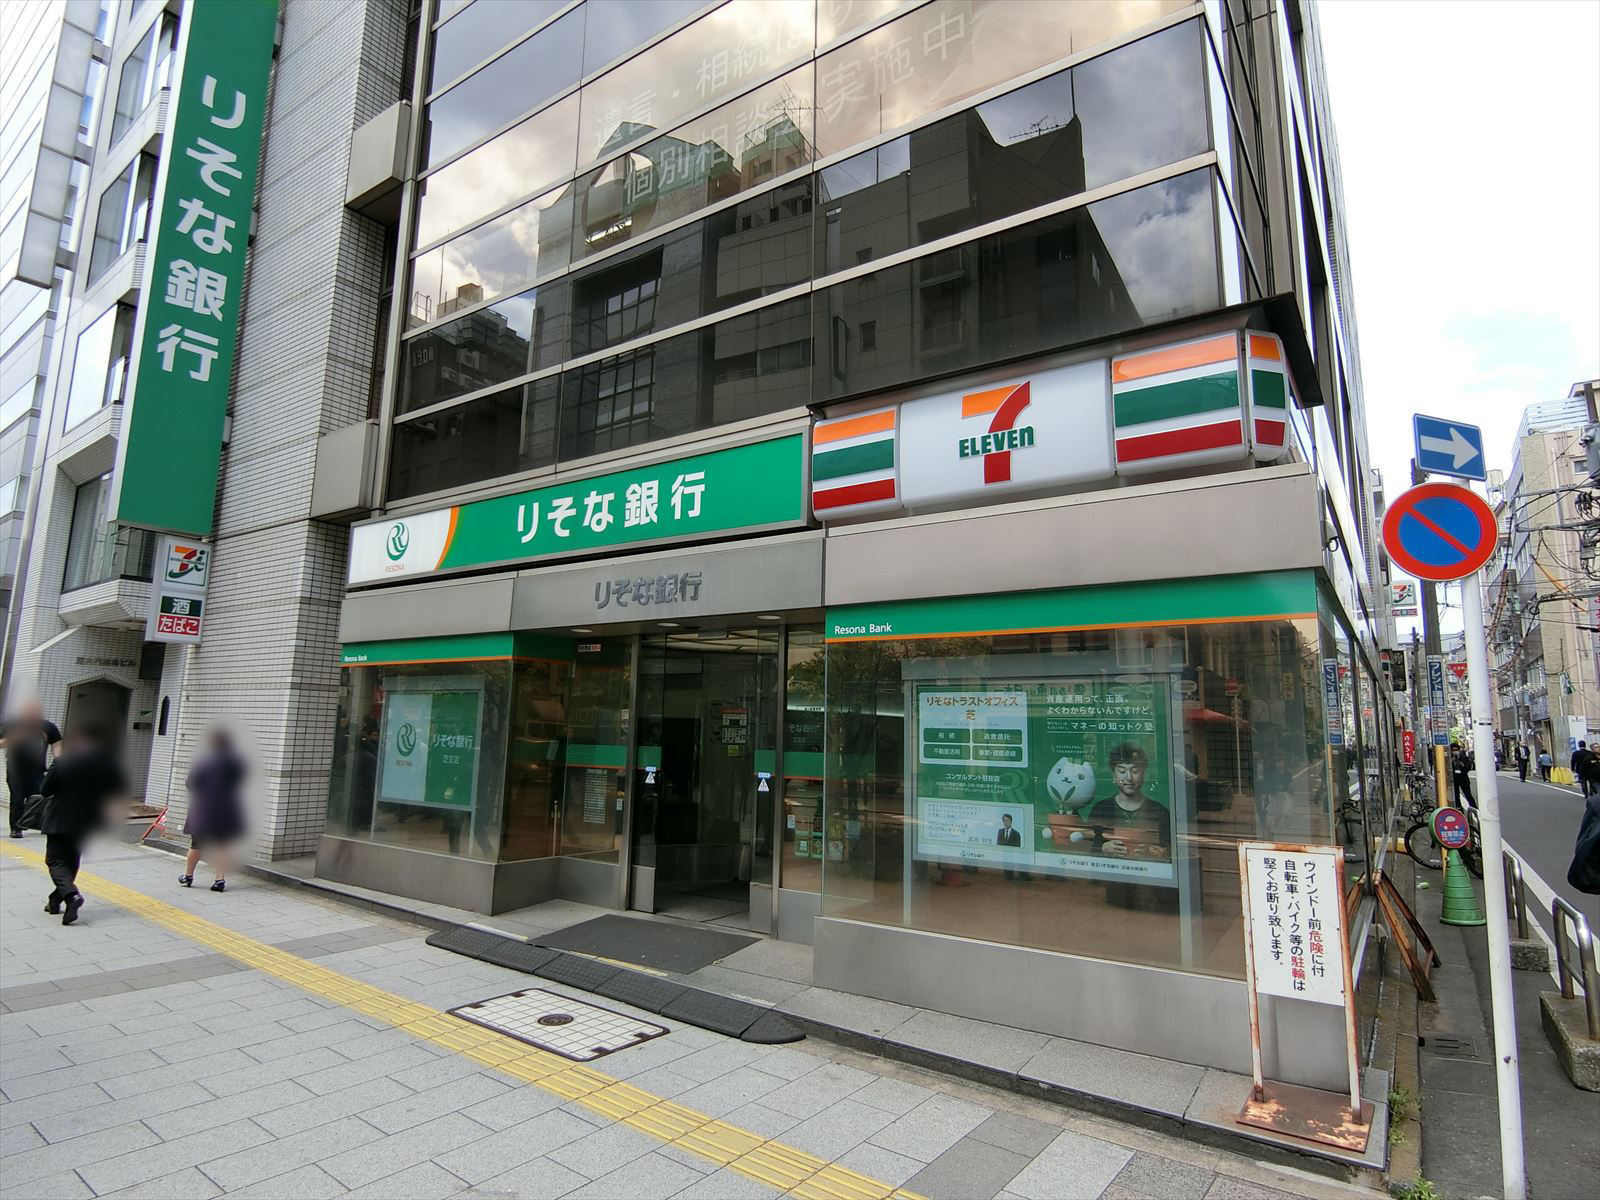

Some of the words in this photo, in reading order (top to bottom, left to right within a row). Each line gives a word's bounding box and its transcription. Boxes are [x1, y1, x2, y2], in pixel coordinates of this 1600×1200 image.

[156, 75, 246, 382] りそな銀行
[517, 470, 706, 544] りそな銀行
[385, 564, 405, 574] RESONA
[594, 571, 702, 609] りそな銀行
[172, 598, 191, 614] 酒
[159, 616, 198, 634] たばこ
[834, 624, 866, 635] Resona
[869, 622, 892, 633] Bank
[344, 654, 358, 662] Resona
[926, 696, 1018, 707] りそなトラストオフィス
[1046, 694, 1128, 704] 資産運用って、正直、
[965, 709, 976, 721] 芝
[1070, 721, 1154, 732] マネーの知っトク塾
[432, 734, 473, 749] りそな銀行
[443, 755, 460, 765] 芝支店
[1263, 857, 1284, 966] 堅くお断り致します。
[1284, 859, 1306, 992] 自転車・バイク等の駐輪は
[1303, 860, 1325, 979] ウインドー前危険に付
